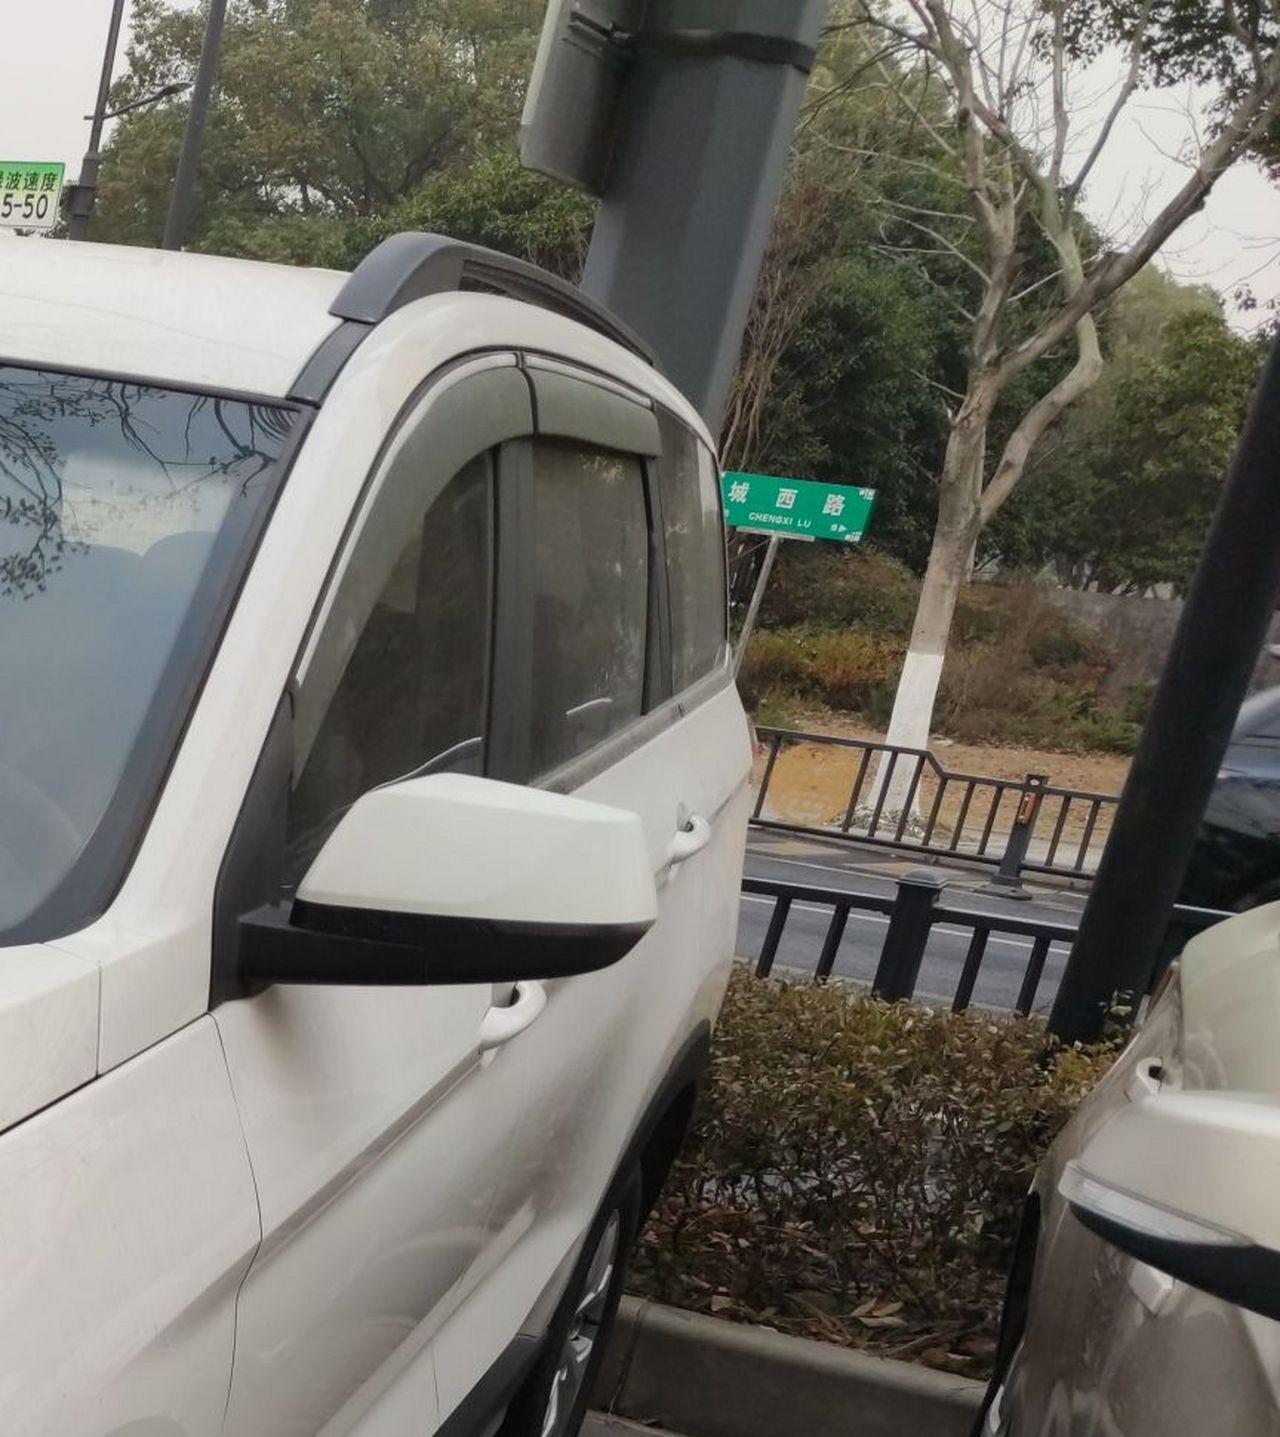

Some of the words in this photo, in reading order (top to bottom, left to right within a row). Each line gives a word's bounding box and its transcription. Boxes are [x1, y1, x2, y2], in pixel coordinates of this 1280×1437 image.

[728, 481, 846, 516] 城西路
[748, 511, 794, 526] CHENGXI
[796, 517, 812, 529] LU
